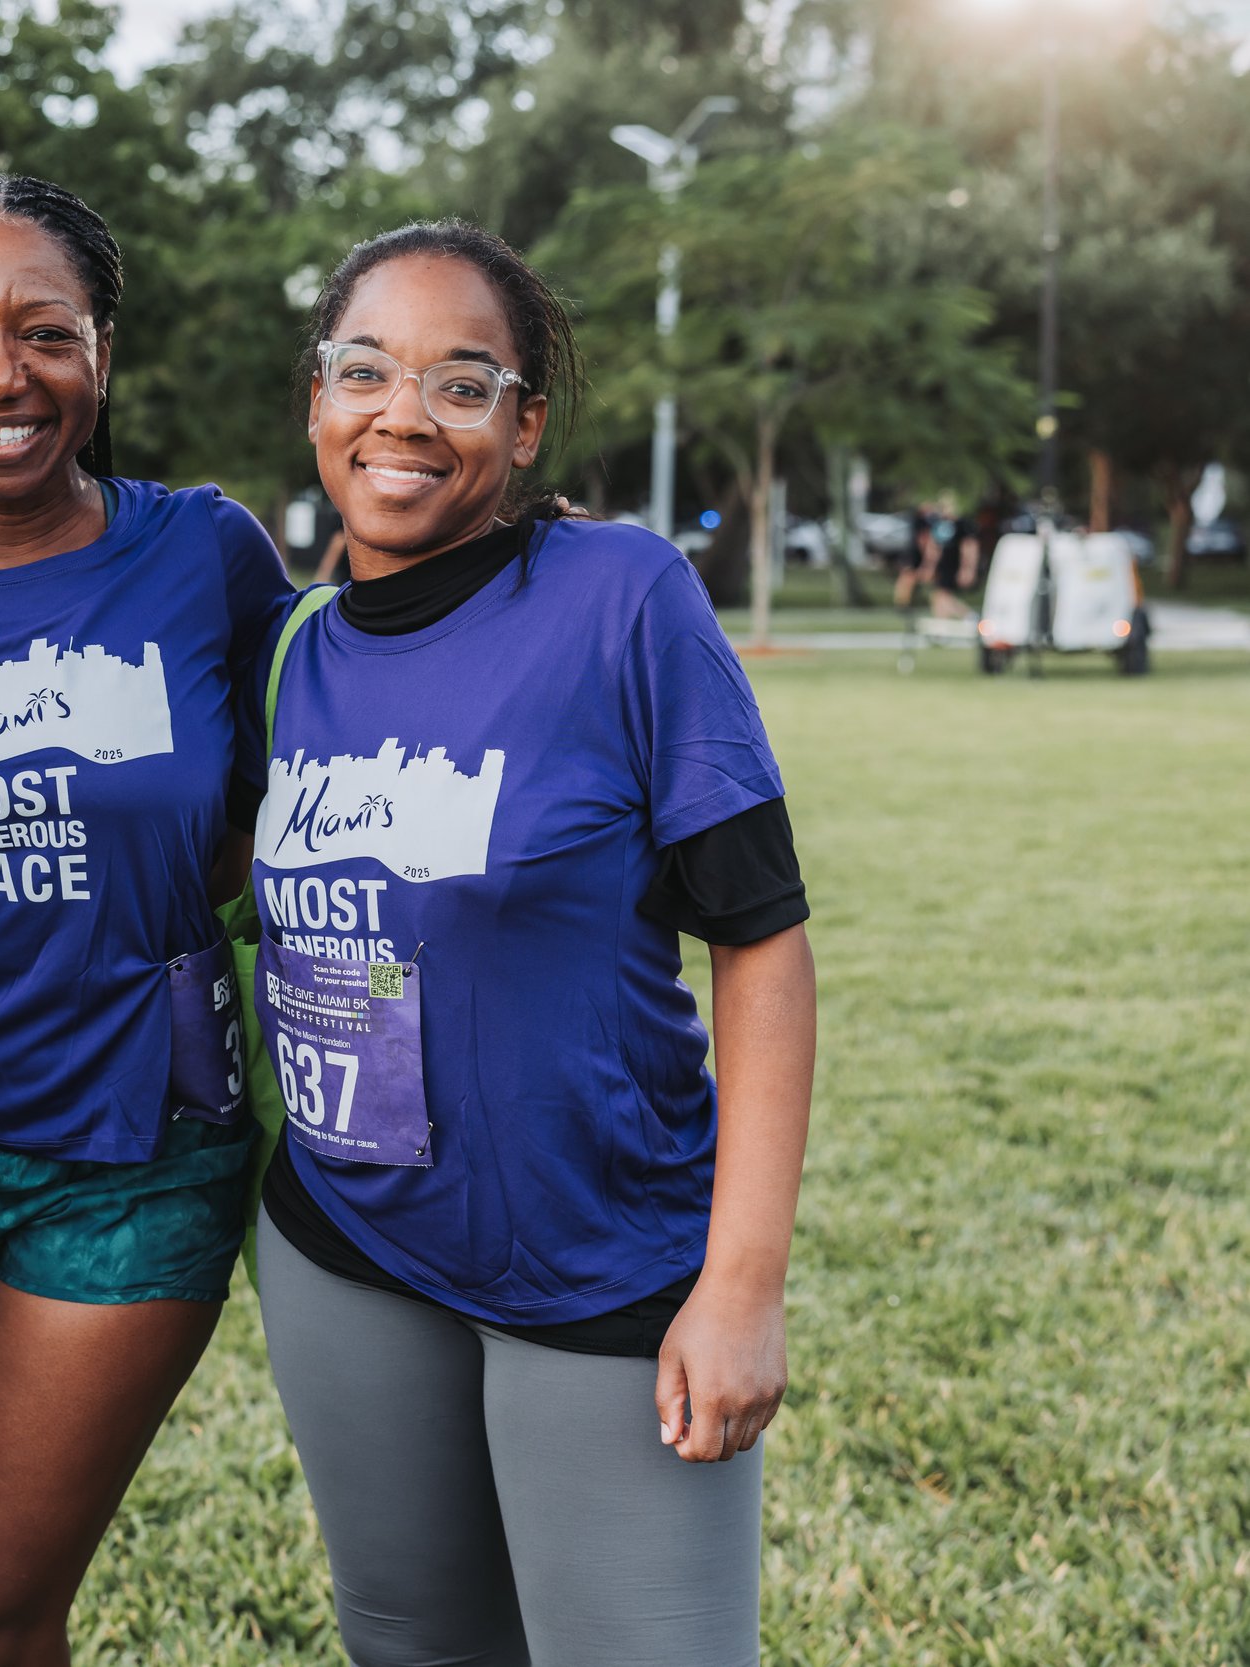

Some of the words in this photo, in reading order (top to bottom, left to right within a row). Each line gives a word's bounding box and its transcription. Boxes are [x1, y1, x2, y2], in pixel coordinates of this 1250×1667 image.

[93, 748, 123, 760] 2025
[273, 775, 394, 857] Miami's
[403, 865, 430, 878] 2025
[263, 877, 387, 932] MOST
[282, 931, 396, 962] ENEROUS
[312, 964, 329, 974] Scan
[329, 967, 342, 975] the
[342, 968, 361, 977] code
[314, 974, 323, 983] for
[324, 977, 341, 985] your
[341, 978, 368, 988] results!
[280, 979, 294, 997] THE
[294, 987, 315, 1003] GIVE
[317, 993, 350, 1009] MIAMI
[353, 998, 370, 1010] 5K
[282, 1003, 371, 1033] RACE+FESTIVAL
[294, 1026, 302, 1038] The
[302, 1030, 318, 1043] Miami
[318, 1035, 351, 1049] Foundation
[225, 1010, 245, 1097] 3
[276, 1031, 359, 1133] 637
[321, 1131, 328, 1140] to
[328, 1134, 340, 1143] find
[340, 1137, 355, 1147] your
[356, 1140, 380, 1149] cause.
